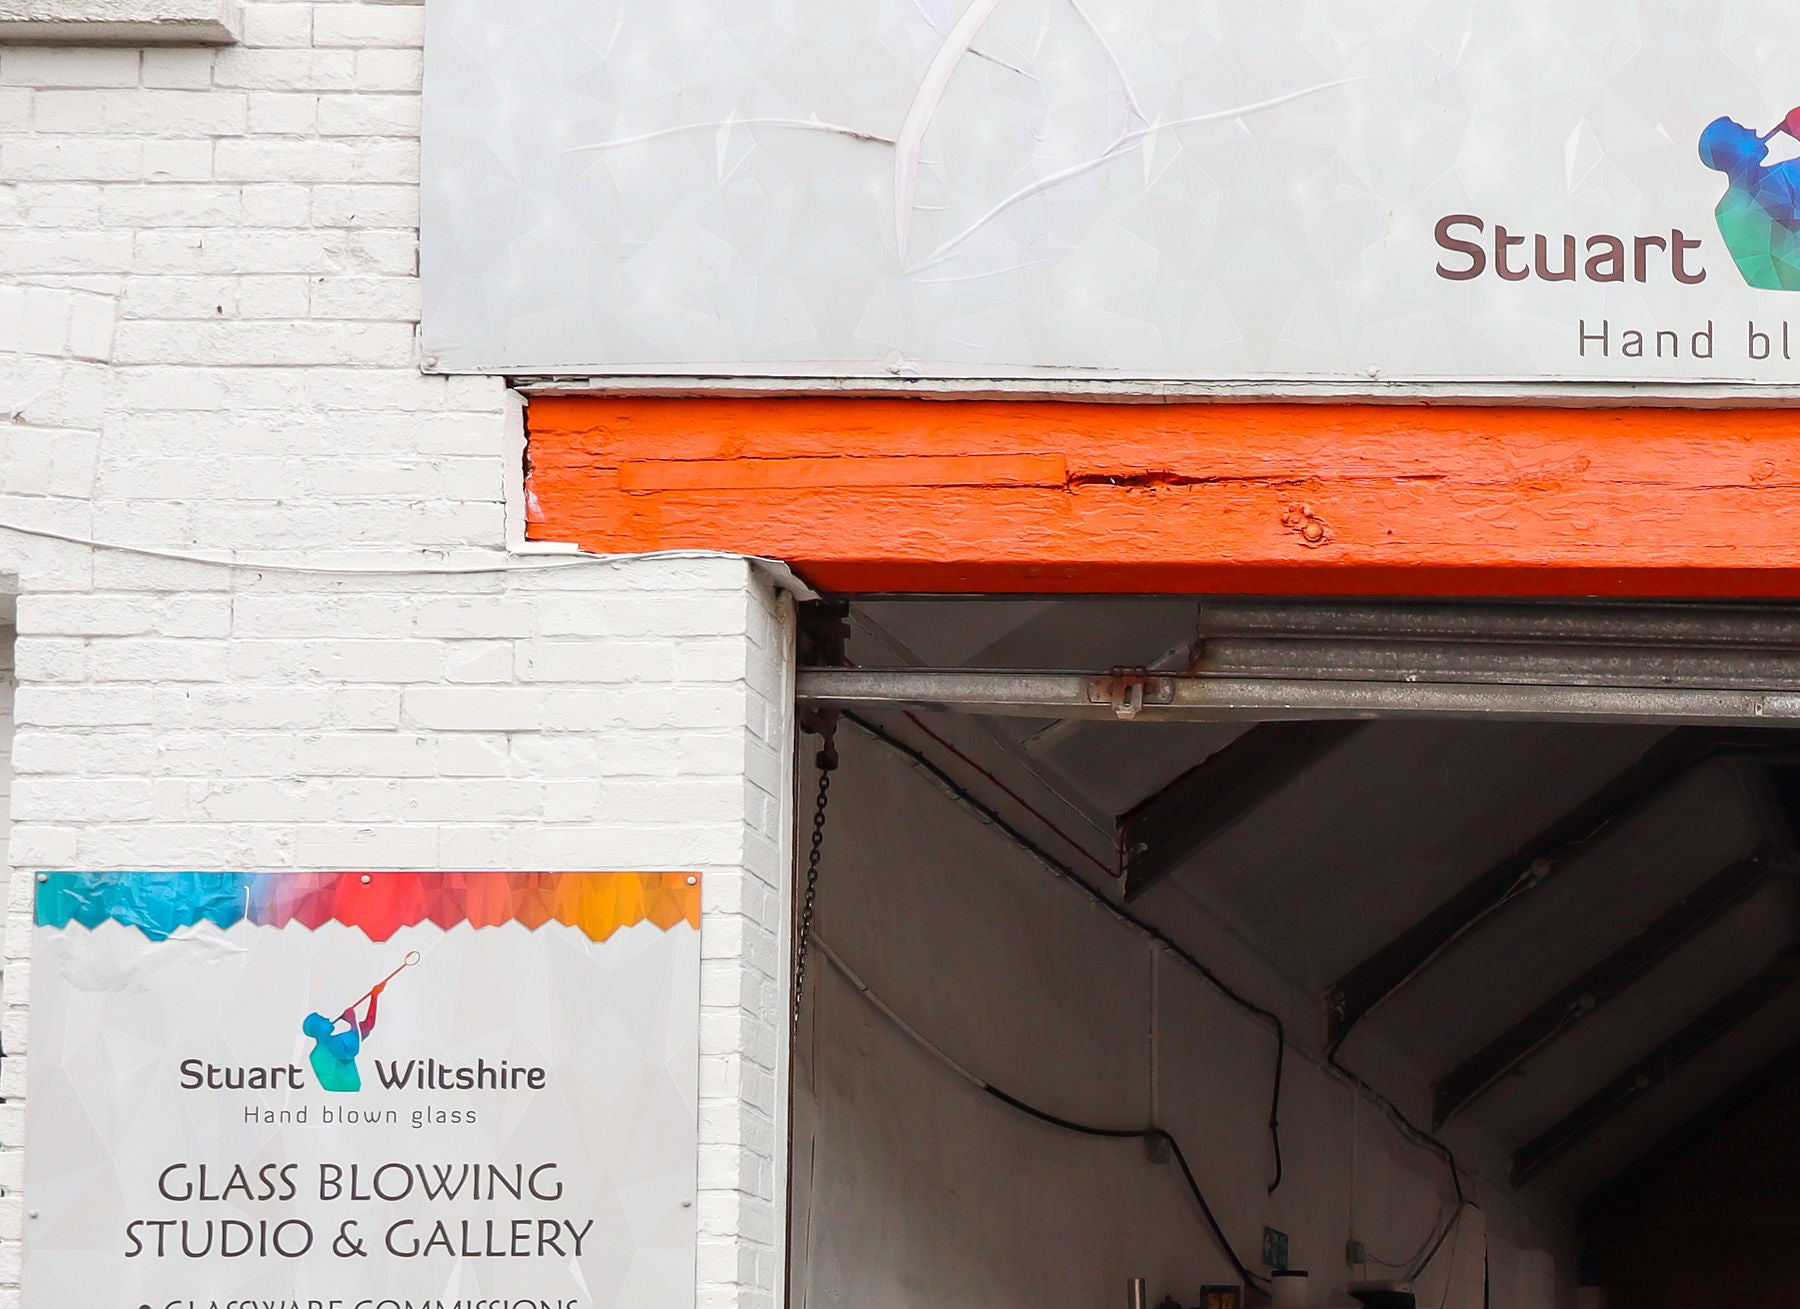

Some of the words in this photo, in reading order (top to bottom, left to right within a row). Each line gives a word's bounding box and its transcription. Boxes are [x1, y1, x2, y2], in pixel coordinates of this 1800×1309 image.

[1434, 214, 1707, 285] Stuart
[1579, 319, 1713, 359] Hand
[180, 1058, 305, 1090] Stuart
[374, 1057, 546, 1090] Wiltshire
[244, 1105, 307, 1124] Hand
[322, 1105, 397, 1124] blown
[411, 1105, 476, 1129] glass
[158, 1163, 298, 1202] GLASS
[319, 1162, 563, 1202] BLOWING
[124, 1219, 314, 1259] STUDIO
[332, 1219, 368, 1258] &
[385, 1219, 594, 1258] GALLERY
